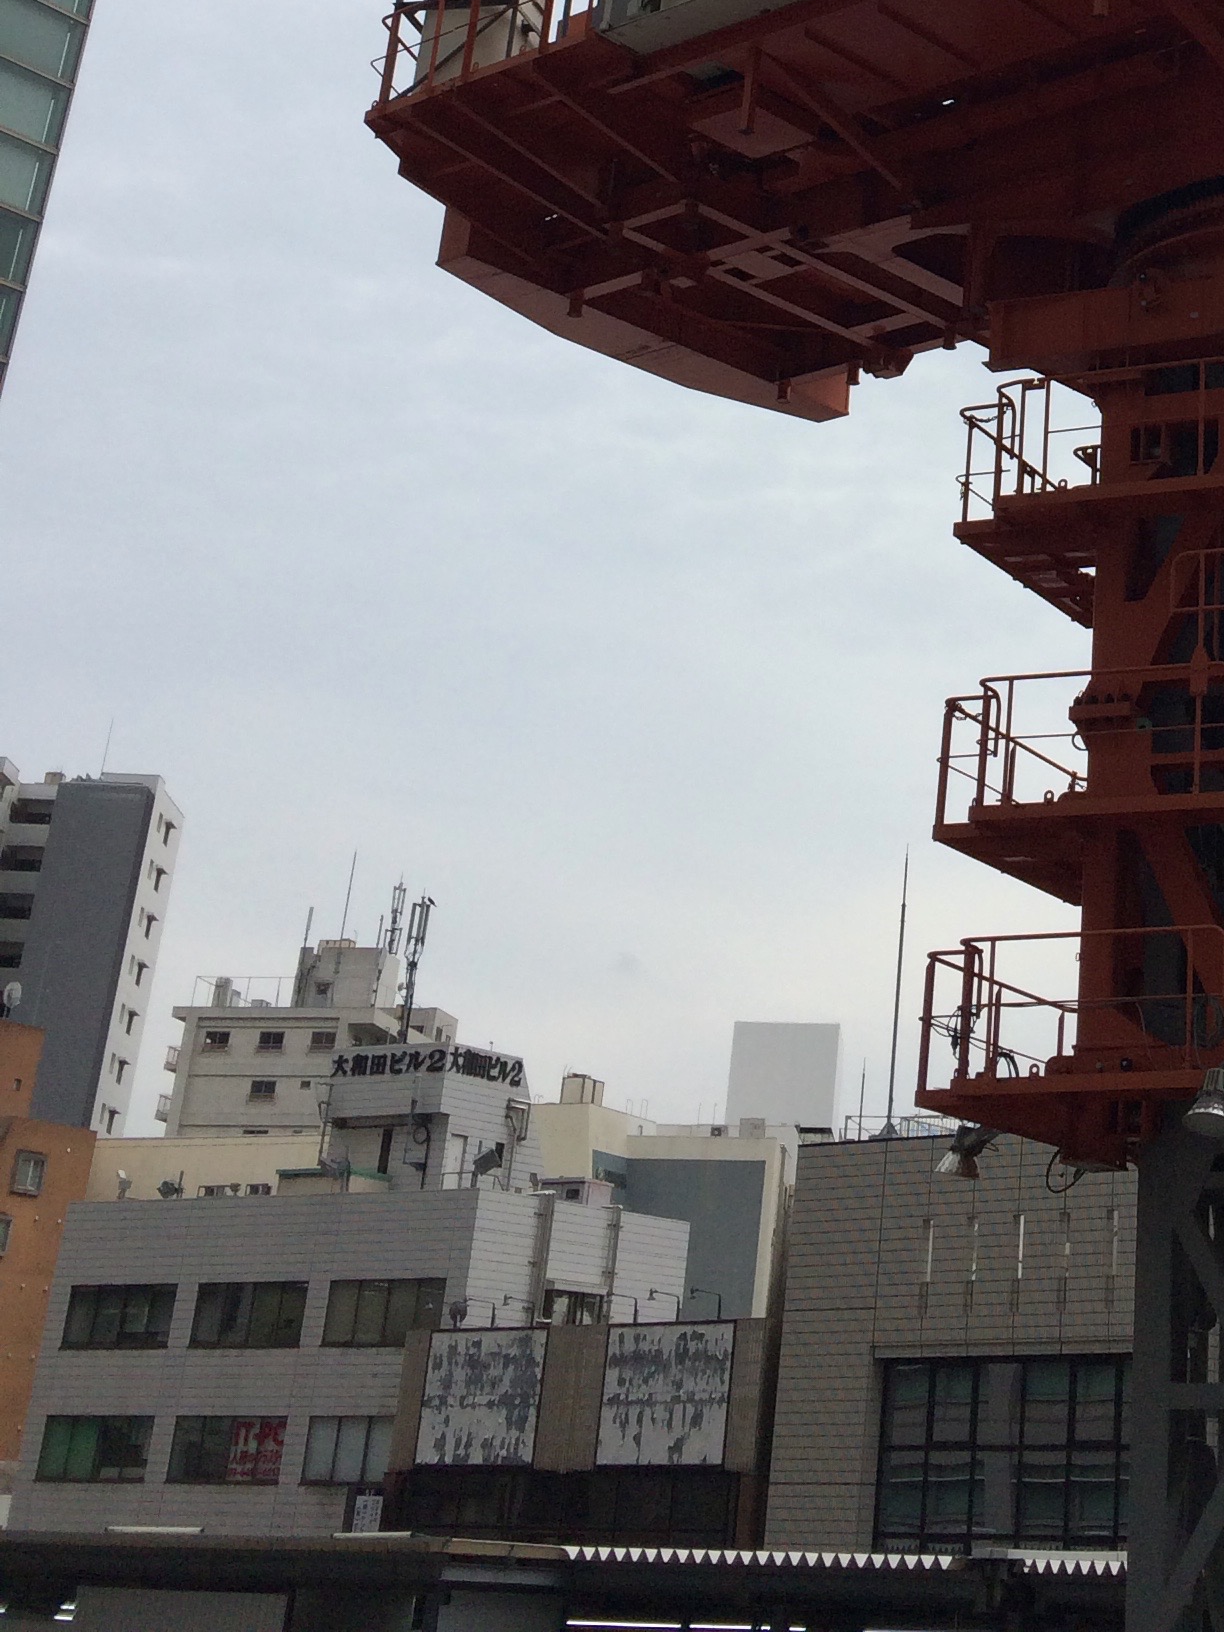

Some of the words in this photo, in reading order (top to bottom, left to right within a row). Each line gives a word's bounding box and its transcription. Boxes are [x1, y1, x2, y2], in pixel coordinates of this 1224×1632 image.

[330, 1049, 446, 1078] 大和田ビル2
[447, 1046, 524, 1087] 大和田ビル2
